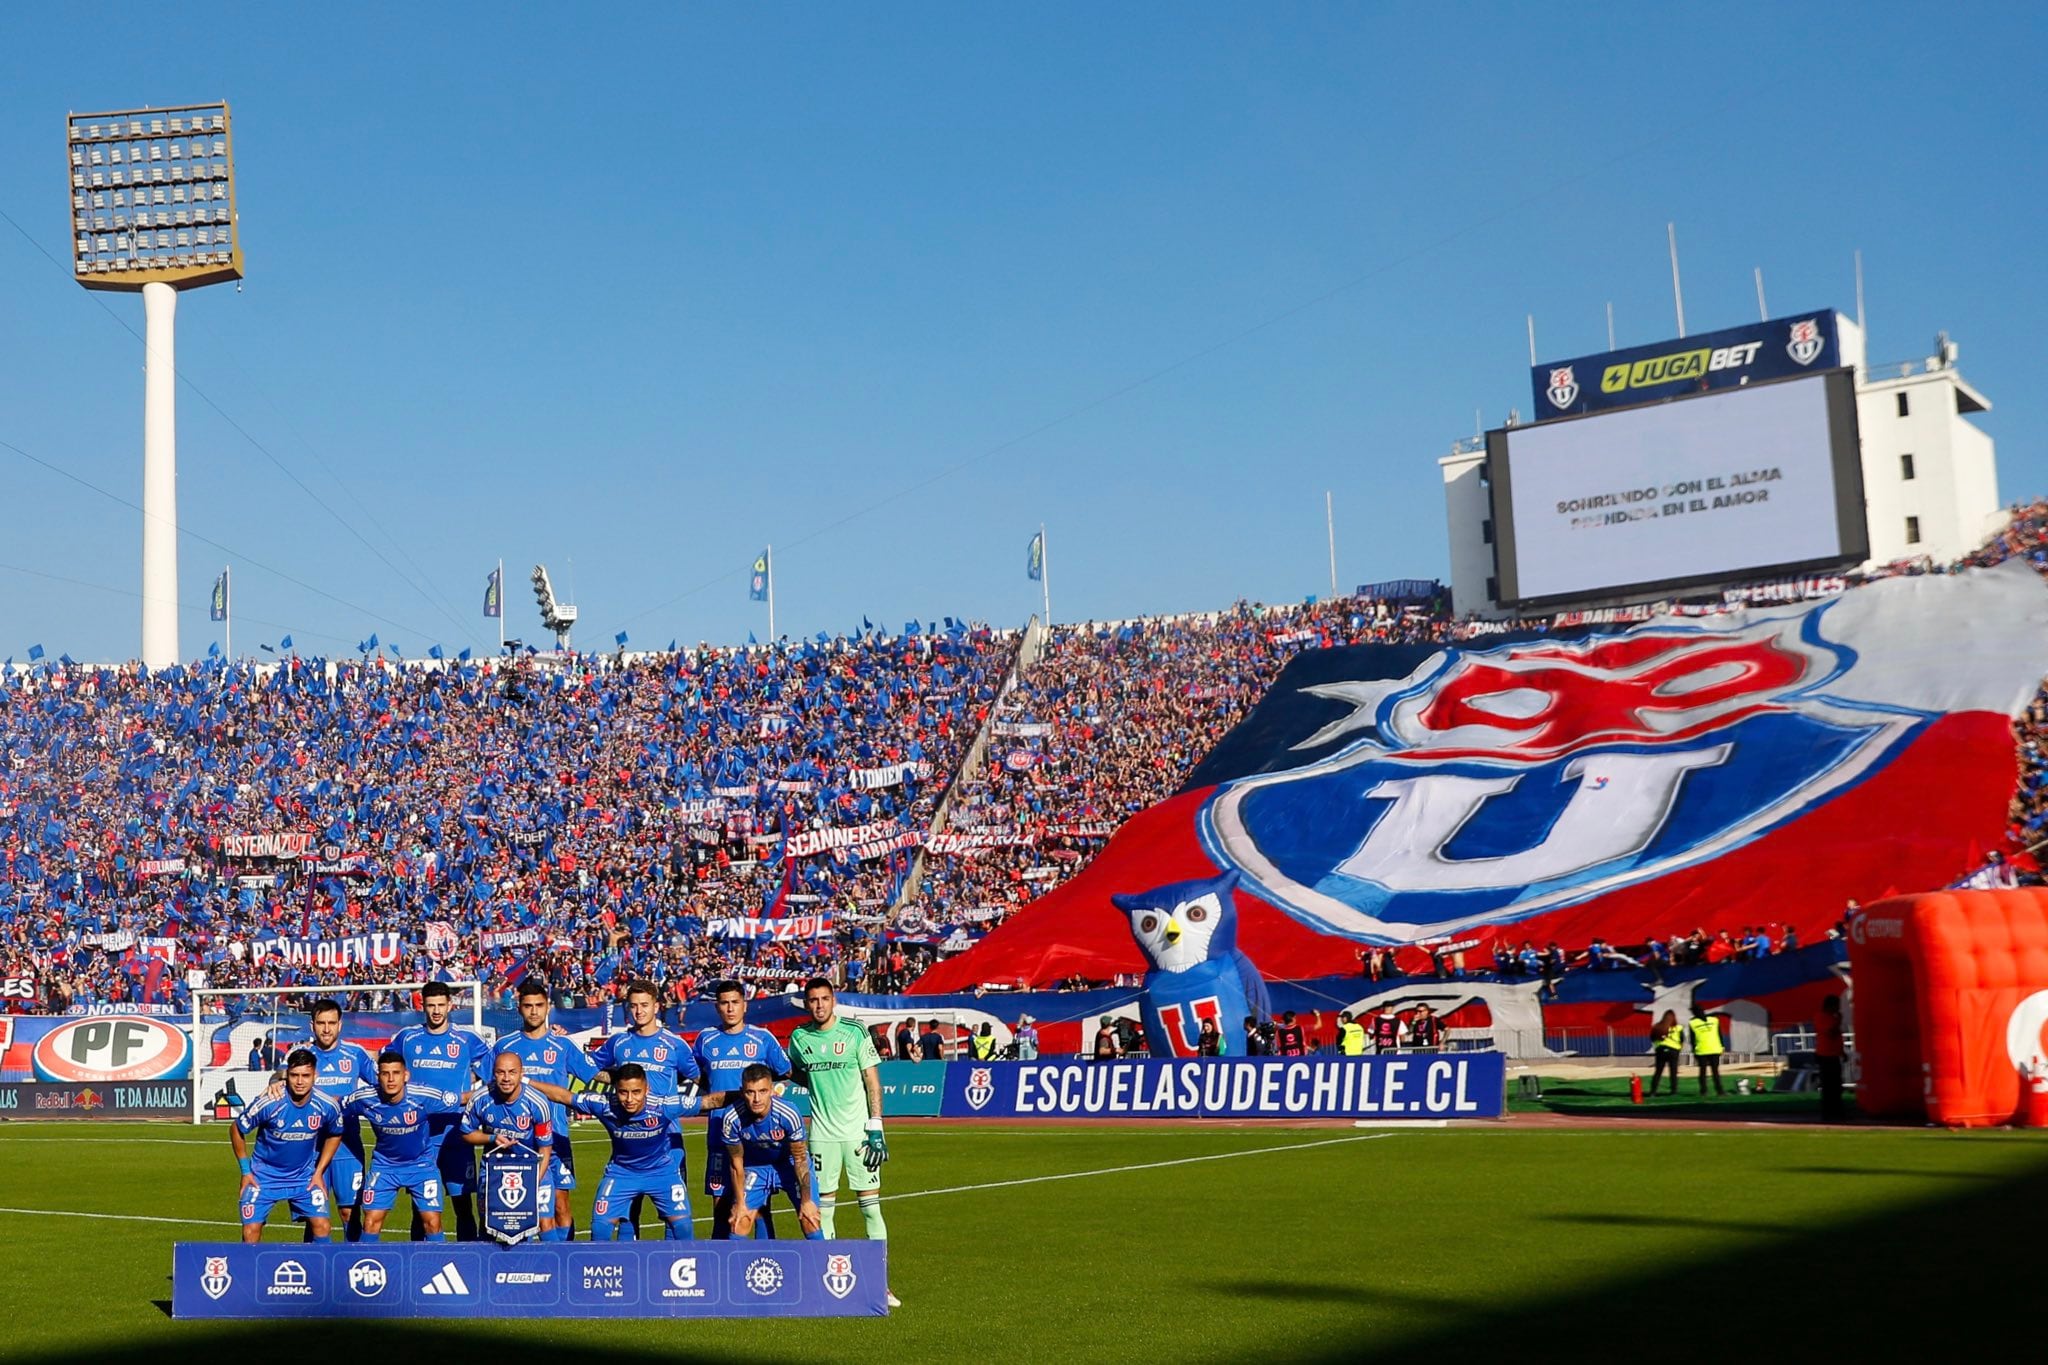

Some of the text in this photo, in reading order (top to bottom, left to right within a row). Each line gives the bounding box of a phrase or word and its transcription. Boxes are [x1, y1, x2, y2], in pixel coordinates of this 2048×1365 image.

[1663, 480, 1702, 498] CON
[1706, 477, 1725, 491] EL
[1729, 468, 1782, 488] ALMA
[1662, 503, 1685, 517] EN
[1690, 498, 1708, 512] EL
[1712, 488, 1769, 510] AMOR
[224, 833, 309, 857] CISTERNAZUL
[786, 823, 883, 857] SCANNERS
[0, 978, 34, 999] ES
[70, 1021, 150, 1068] PF
[883, 1085, 896, 1095] TV
[911, 1085, 935, 1094] FIJO
[1015, 1060, 1478, 1113] ESCUELASUDECHILE.CL
[114, 1087, 187, 1109] TE DA AAALAS
[583, 1265, 623, 1277] MACH
[267, 1285, 313, 1295] SODIMAC
[583, 1278, 623, 1289] BANK
[662, 1289, 705, 1297] GATORADE
